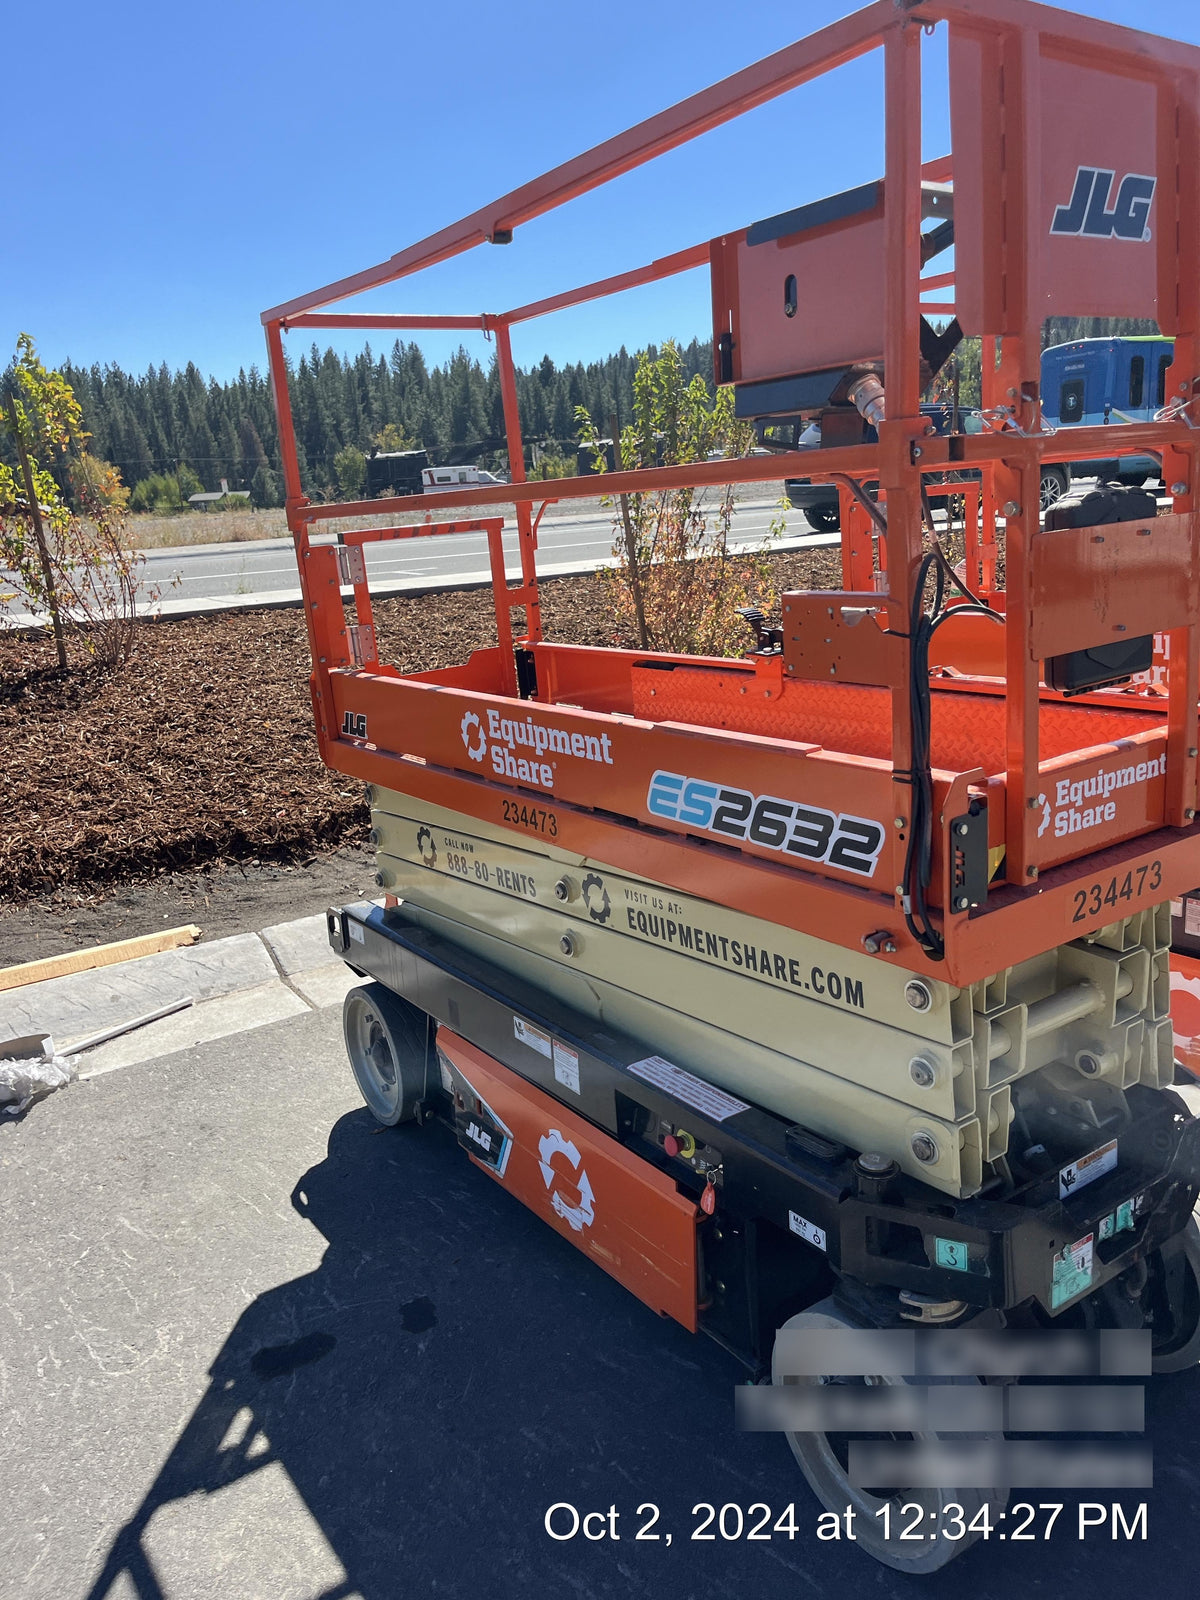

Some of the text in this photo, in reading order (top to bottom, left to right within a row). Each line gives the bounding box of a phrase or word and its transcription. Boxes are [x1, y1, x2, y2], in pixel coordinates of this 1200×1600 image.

[1050, 165, 1157, 242] JLG
[341, 710, 368, 739] JLG
[488, 708, 614, 765] Equipment
[492, 746, 554, 788] Share
[1055, 753, 1167, 807] Equipment
[502, 800, 559, 837] 234473
[647, 769, 886, 877] ES2632
[1054, 800, 1117, 837] Share
[444, 837, 474, 853] CALL NOW
[446, 852, 537, 897] 888-80-RENTS
[1072, 860, 1162, 923] 234473
[624, 889, 682, 914] VISIT US AT:
[626, 907, 865, 1009] EQUIPMENTSHARE.COM
[465, 1121, 492, 1152] JLG
[793, 1215, 807, 1228] MAX
